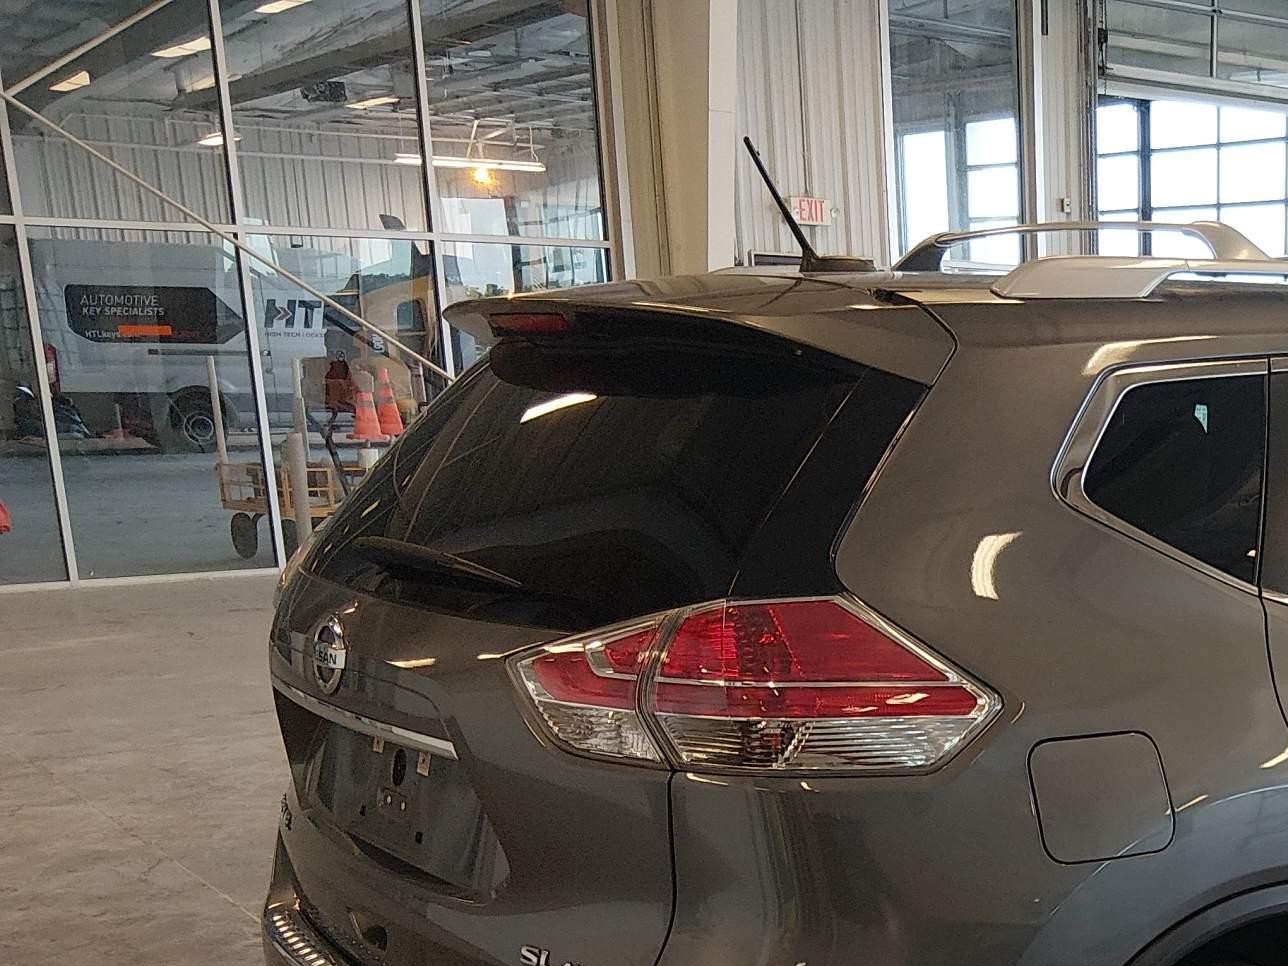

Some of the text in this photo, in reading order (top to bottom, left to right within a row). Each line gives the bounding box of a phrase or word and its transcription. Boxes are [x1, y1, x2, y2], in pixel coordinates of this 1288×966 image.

[799, 199, 825, 222] EXIT
[80, 294, 160, 306] AUTOMOTIVE
[82, 306, 165, 317] KEY SPECIALISTS
